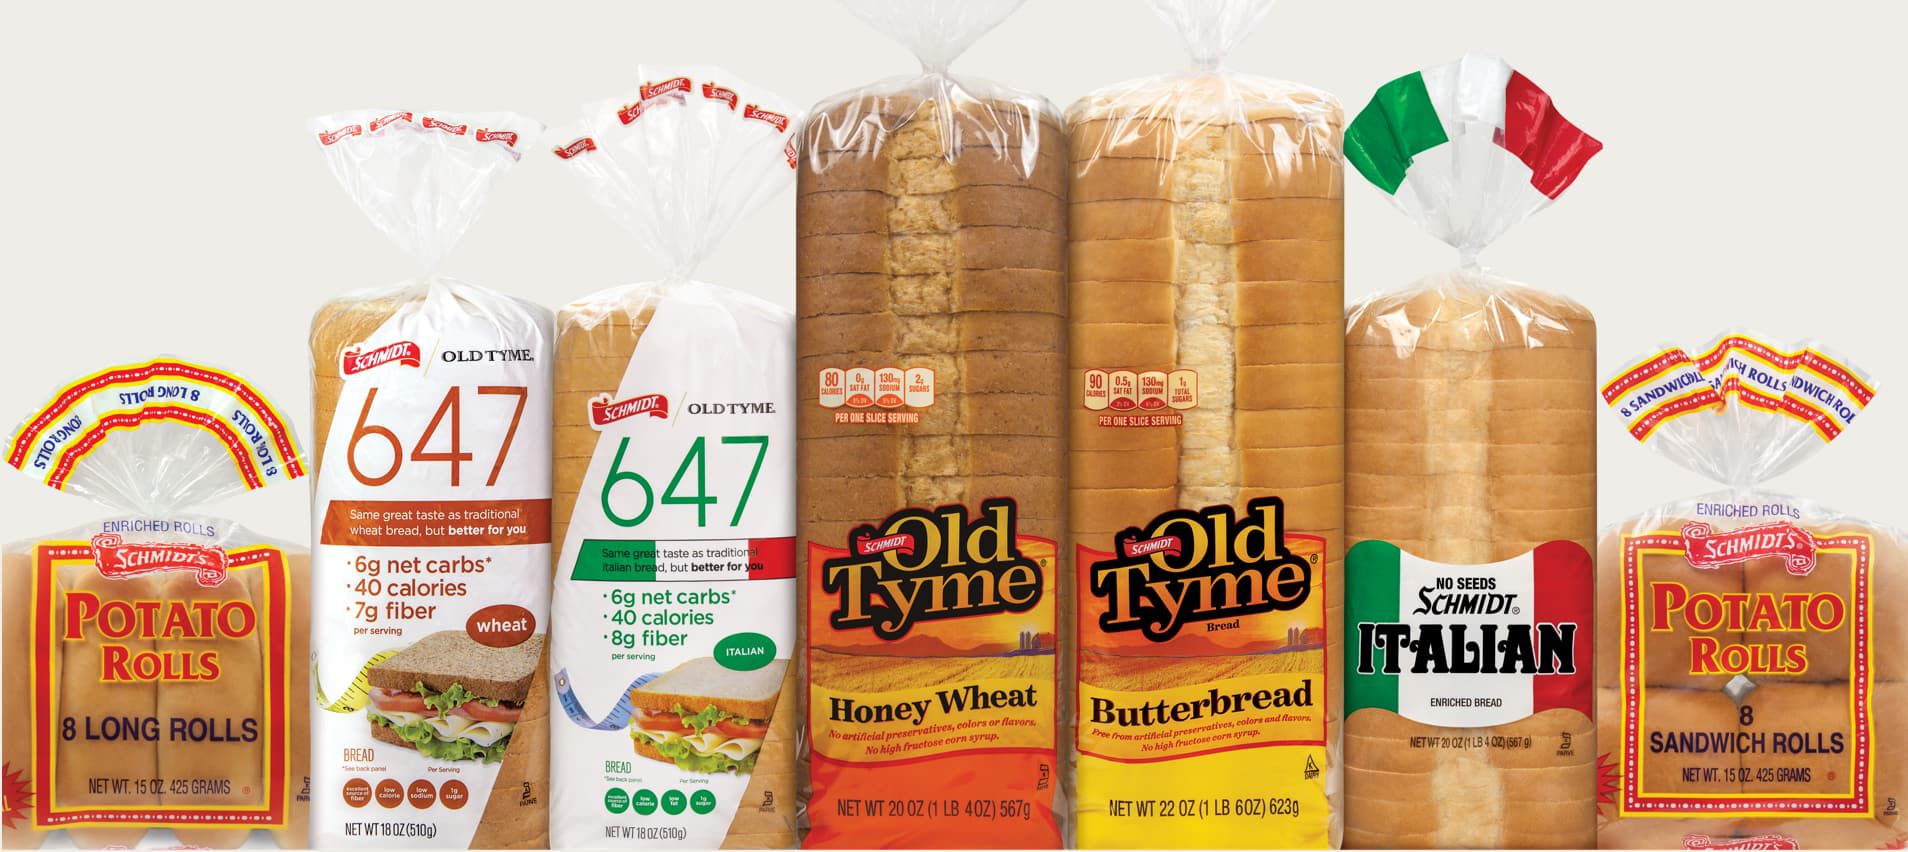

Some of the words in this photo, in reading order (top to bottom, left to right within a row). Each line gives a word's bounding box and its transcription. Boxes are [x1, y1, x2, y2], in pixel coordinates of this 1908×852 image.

[648, 78, 685, 97] SCHMIDT
[352, 342, 411, 371] SCHMIDT
[443, 350, 482, 362] OLD
[484, 349, 532, 361] TYME
[825, 372, 838, 386] 80
[1090, 374, 1102, 389] 90
[1748, 369, 1788, 392] ROLLS
[190, 390, 200, 401] 8
[603, 396, 659, 421] SCHMIDT
[688, 403, 725, 415] OLD
[730, 402, 776, 414] TYME
[836, 413, 848, 423] PER
[850, 413, 864, 423] ONE
[866, 413, 886, 423] SLICE
[888, 413, 918, 423] SERVING
[1620, 408, 1631, 418] 8
[232, 410, 262, 446] ROLLS
[1099, 416, 1111, 424] PER
[1114, 416, 1127, 425] ONE
[1129, 416, 1149, 426] SLICE
[1151, 416, 1181, 425] SERVING
[347, 386, 528, 486] 647
[601, 436, 769, 527] 647
[350, 510, 379, 520] Same
[383, 510, 412, 521] great
[416, 510, 444, 520] taste
[448, 511, 460, 520] as
[464, 509, 520, 519] traditional
[1697, 503, 1758, 517] ENRICHED
[1762, 504, 1800, 519] ROLLS
[103, 520, 170, 532] ENRICHED
[173, 521, 215, 537] ROLLS
[350, 526, 382, 535] wheat
[386, 526, 421, 536] bread,
[425, 526, 444, 535] but
[449, 525, 484, 535] better
[488, 525, 504, 535] for
[507, 526, 526, 536] you
[883, 505, 1015, 572] Old
[864, 535, 907, 553] SCHMIDT
[1131, 537, 1174, 555] SCHMIDT
[1151, 505, 1283, 573] Old
[1704, 530, 1797, 559] SCHMIDT'S
[116, 548, 208, 569] SCHMIDT'S
[355, 556, 380, 576] 6g
[388, 557, 421, 573] net
[354, 579, 381, 596] 40
[387, 579, 467, 597] calories
[1436, 578, 1453, 589] NO
[1457, 578, 1496, 590] SEEDS
[611, 589, 635, 608] 6g
[642, 589, 672, 605] net
[829, 561, 1036, 632] Tyme
[1098, 562, 1305, 634] Tyme
[1413, 586, 1518, 615] SCHMIDT
[1651, 582, 1845, 631] POTATO
[64, 592, 256, 640] POTATO
[355, 602, 378, 622] 7g
[386, 602, 436, 619] fiber
[611, 610, 636, 625] 40
[642, 609, 714, 625] calories
[370, 627, 402, 636] serving
[476, 618, 527, 633] wheat
[1207, 620, 1240, 632] Bread
[612, 630, 635, 648] 8g
[642, 630, 688, 646] fiber
[1357, 623, 1577, 675] ITALIAN
[726, 647, 764, 656] ITALIAN
[1689, 637, 1808, 675] ROLLS
[100, 646, 220, 682] ROLLS
[829, 697, 932, 725] Honey
[936, 685, 1037, 714] Wheat
[1090, 679, 1313, 727] Butterbread
[1430, 698, 1472, 707] ENRICHED
[1474, 698, 1502, 708] BREAD
[1740, 705, 1754, 726] 8
[62, 717, 76, 740] 8
[86, 716, 160, 740] LONG
[170, 717, 258, 742] ROLLS
[829, 730, 841, 739] No
[842, 731, 885, 742] artificial
[885, 722, 955, 742] preservatives,
[957, 719, 987, 729] colors
[1002, 717, 1036, 727] flavors.
[1091, 728, 1110, 739] Free
[1112, 731, 1132, 741] from
[1134, 730, 1172, 741] artificial
[1174, 721, 1235, 738] preservatives,
[1237, 717, 1263, 727] colors
[1264, 716, 1281, 724] and
[1282, 714, 1312, 723] flavors.
[1650, 731, 1765, 754] SANDWICH
[1773, 732, 1844, 754] ROLLS
[344, 749, 374, 762] BREAD
[605, 761, 631, 773] BREAD
[1682, 768, 1700, 782] NET
[1703, 768, 1721, 782] WT.
[1724, 769, 1735, 782] 15
[1738, 768, 1753, 782] OZ.
[1756, 768, 1774, 782] 425
[1777, 768, 1811, 782] GRAMS
[89, 779, 110, 794] NET
[112, 779, 131, 794] WT.
[135, 779, 146, 794] 15
[150, 779, 166, 794] OZ.
[170, 779, 188, 794] 425
[192, 779, 230, 794] GRAMS
[838, 799, 861, 817] NET
[865, 799, 885, 817] WT
[888, 800, 904, 816] 20
[908, 800, 924, 817] OZ
[928, 799, 938, 820] (1
[944, 800, 959, 817] LB
[1000, 800, 1030, 820] 567g
[1109, 800, 1132, 817] NET
[1137, 800, 1156, 817] WT
[1160, 800, 1175, 816] 22
[1179, 800, 1195, 816] OZ
[1199, 800, 1209, 819] (1
[1215, 800, 1230, 816] LB
[1270, 798, 1299, 817] 623g
[345, 823, 361, 836] NET
[365, 823, 379, 836] WT
[381, 824, 392, 836] 18
[393, 824, 405, 836] OZ
[407, 824, 437, 839] (510g)
